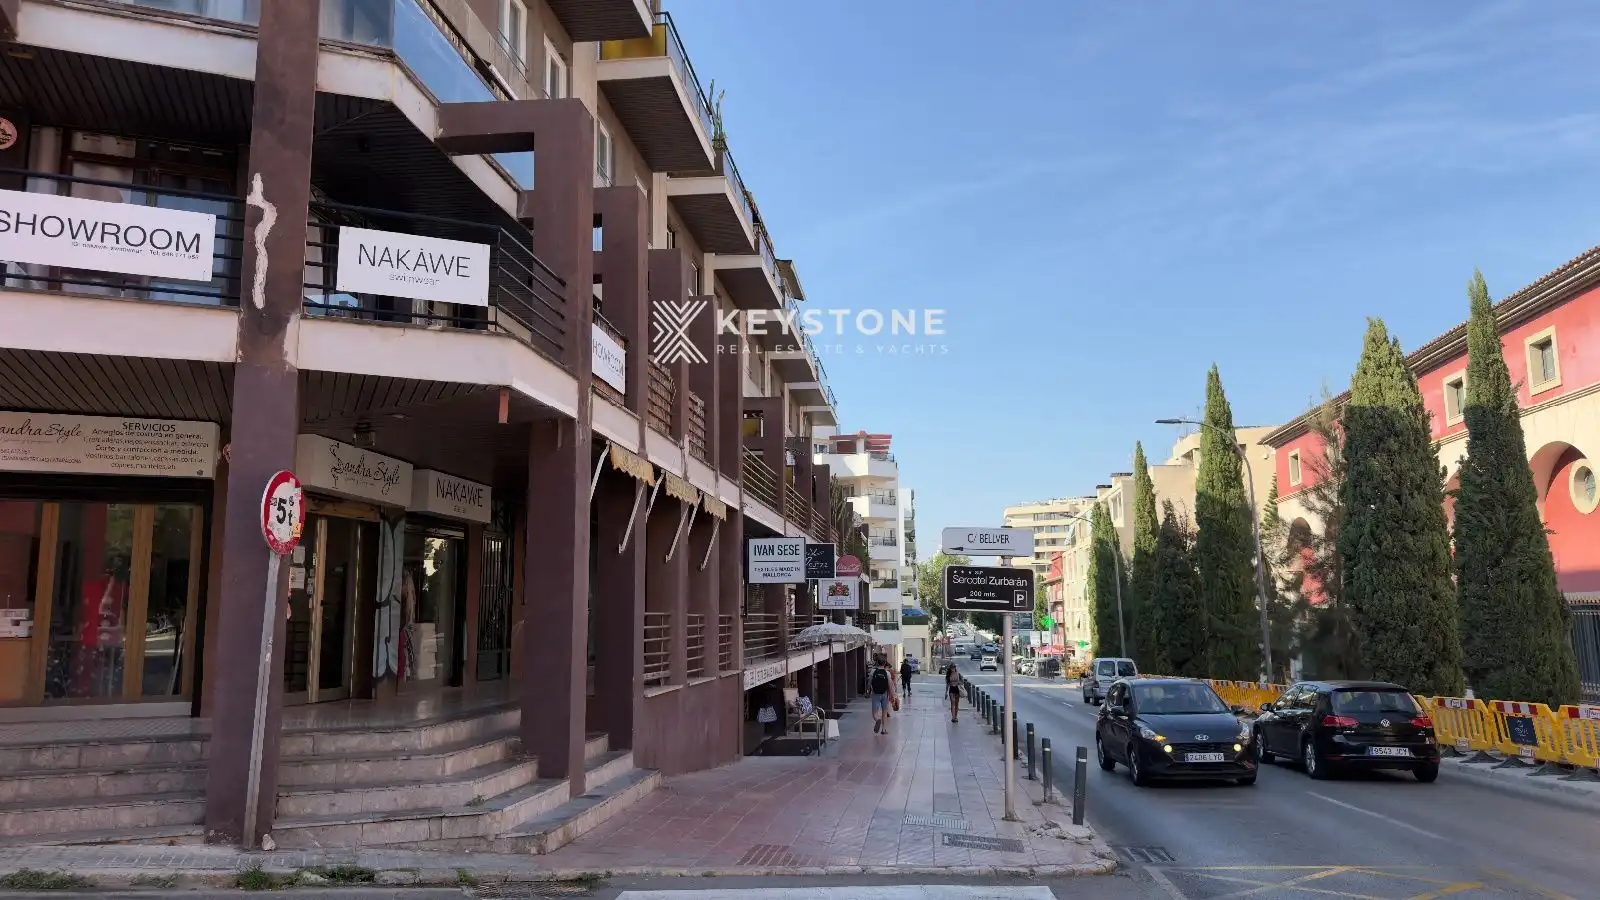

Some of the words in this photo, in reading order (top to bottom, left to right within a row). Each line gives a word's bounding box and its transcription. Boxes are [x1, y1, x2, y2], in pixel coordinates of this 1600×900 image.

[0, 209, 201, 254] SHOWROOM
[122, 421, 176, 433] SERVICIOS
[373, 461, 401, 496] Style
[979, 533, 1010, 544] BELLVER
[754, 543, 775, 556] IVAN
[777, 543, 800, 556] SESE
[1016, 593, 1025, 604] P
